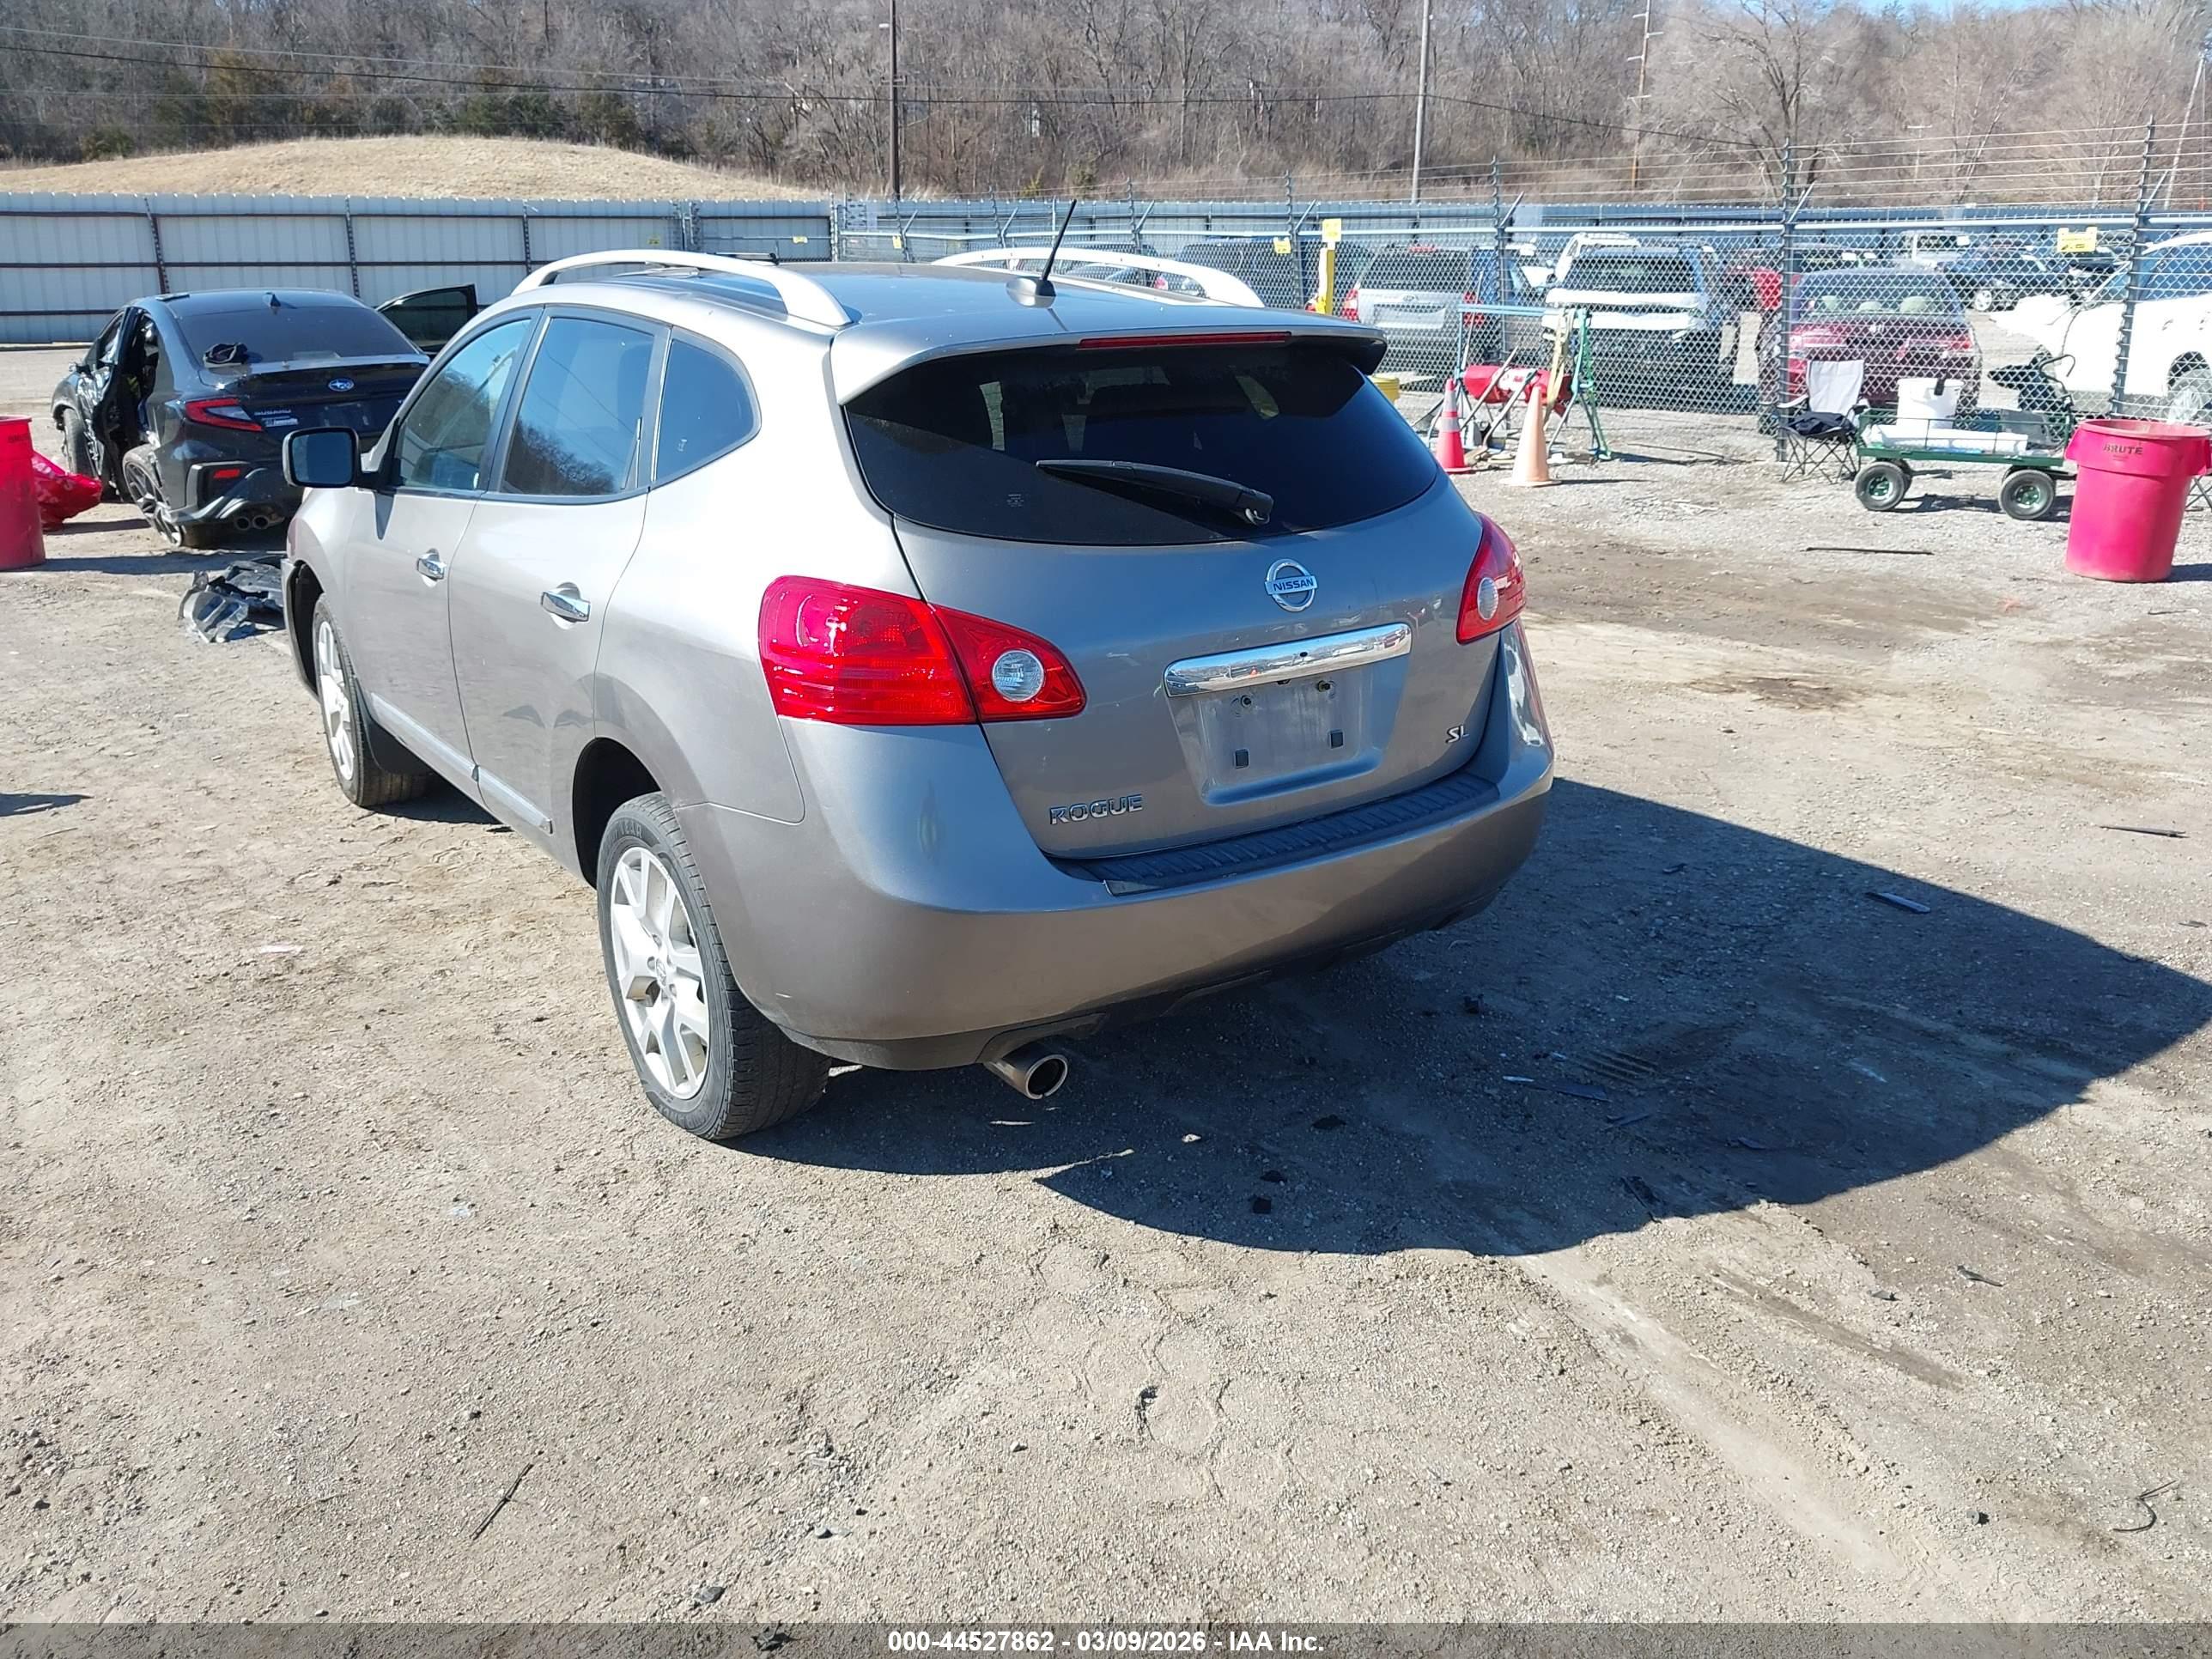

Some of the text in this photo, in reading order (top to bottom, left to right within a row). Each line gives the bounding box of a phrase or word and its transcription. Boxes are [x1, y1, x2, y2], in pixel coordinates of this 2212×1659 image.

[2103, 444, 2143, 455] BRUTE
[1273, 578, 1314, 591] NISSAN
[1447, 726, 1470, 743] SL
[1050, 794, 1143, 824] ROGUE
